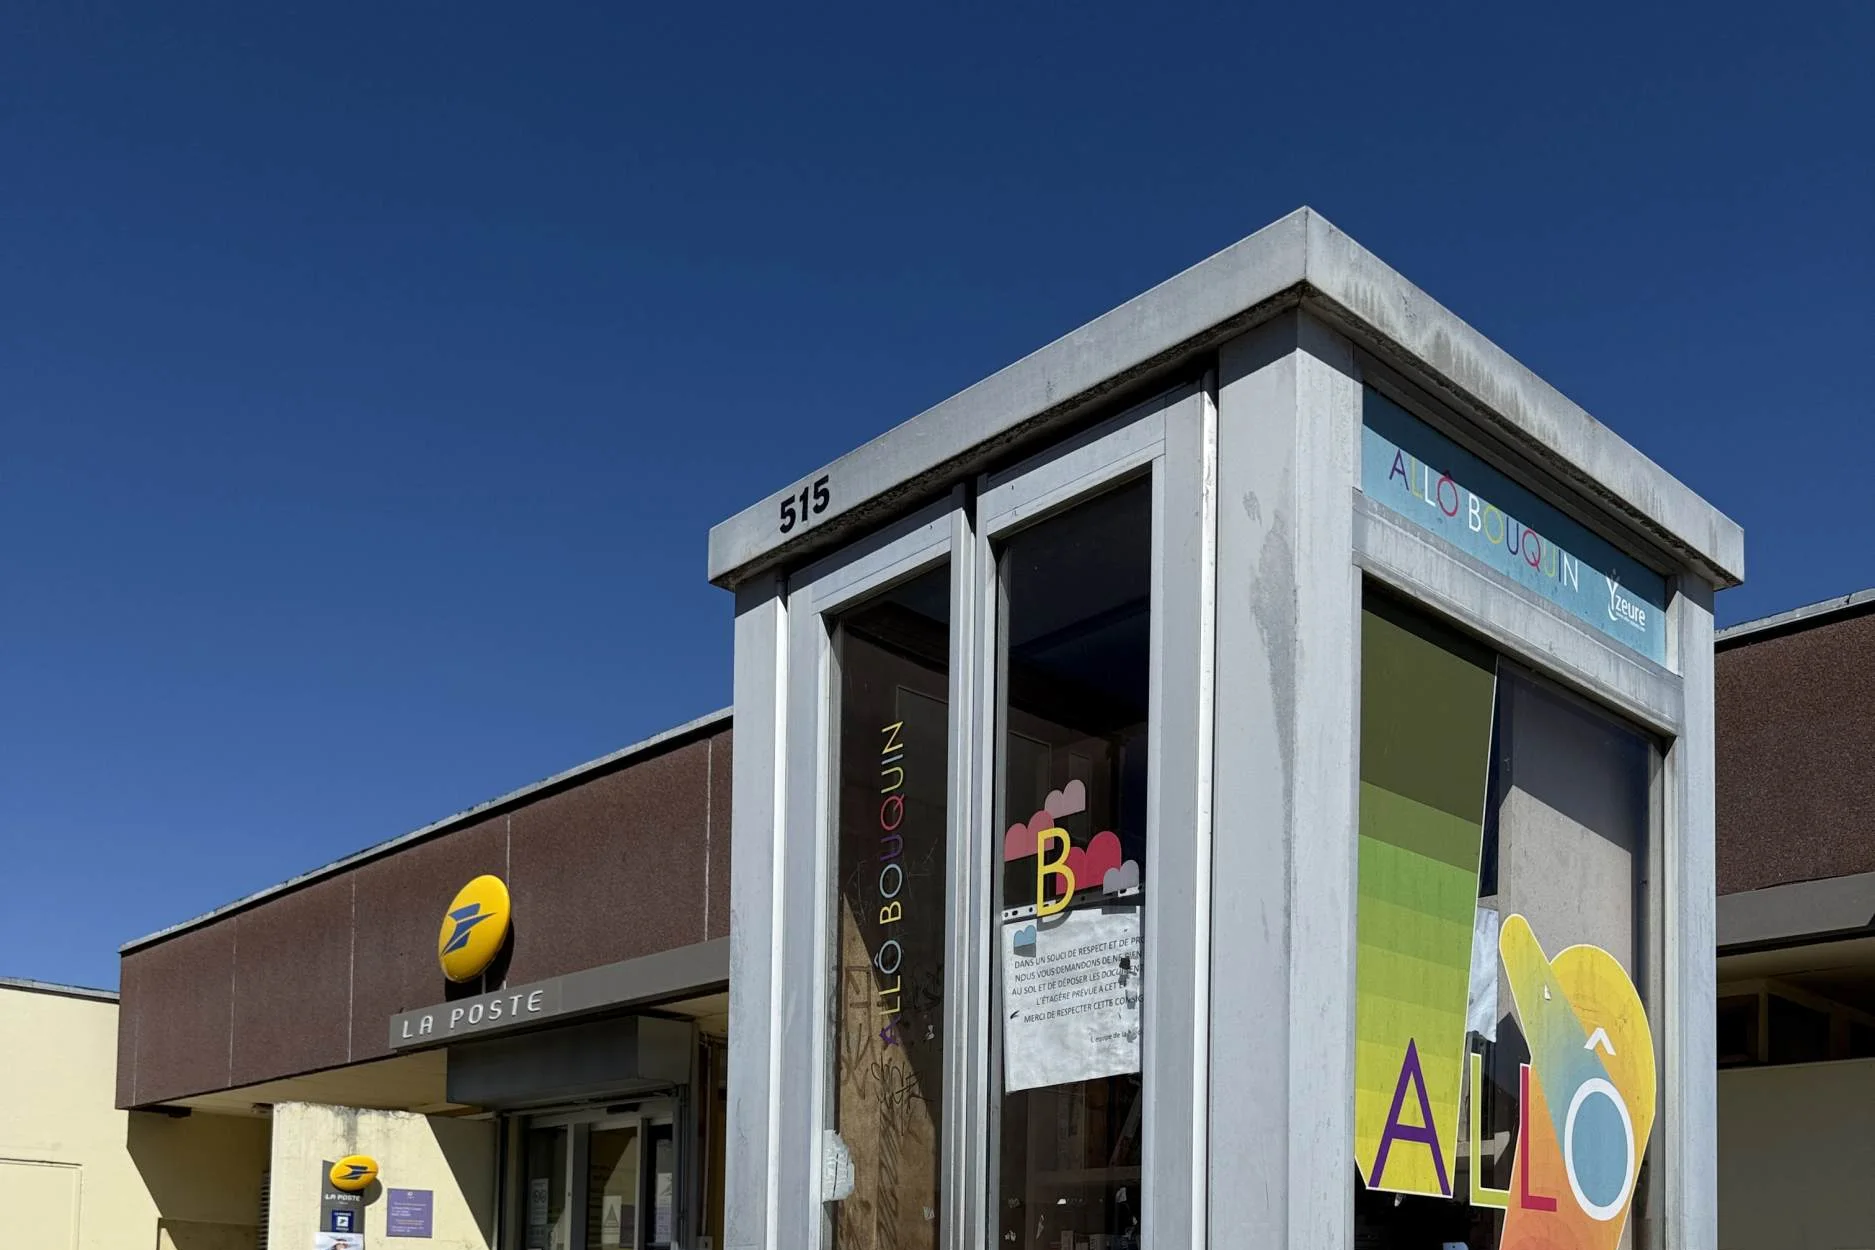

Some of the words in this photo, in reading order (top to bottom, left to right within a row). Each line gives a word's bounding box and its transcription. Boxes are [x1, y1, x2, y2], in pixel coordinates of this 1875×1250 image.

[779, 474, 830, 534] 515
[1467, 493, 1580, 593] BOUQUIN
[1605, 575, 1646, 626] Yzeure
[879, 720, 905, 925] BOUQUIN
[1036, 827, 1076, 918] B
[1014, 957, 1034, 969] DANS
[1035, 955, 1046, 965] UN
[1046, 951, 1067, 963] SOUCI
[1068, 948, 1077, 957] DE
[1078, 942, 1107, 957] RESPECT
[1108, 940, 1118, 950] ET
[1119, 937, 1129, 947] DE
[1015, 971, 1036, 982] NOUS
[1036, 967, 1057, 978] VOUS
[1057, 957, 1101, 975] DEMANDONS
[1101, 955, 1111, 965] DE
[1012, 987, 1022, 996] AU
[1024, 985, 1037, 994] SOL
[1038, 982, 1046, 992] ET
[1047, 980, 1057, 990] DE
[1089, 971, 1101, 981] LES
[402, 1015, 434, 1039] LA
[450, 990, 544, 1029] POSTE
[1023, 1012, 1046, 1023] MERCI
[1046, 1009, 1056, 1019] DE
[1056, 1003, 1092, 1016] RESPECTER
[1093, 998, 1114, 1009] CETTE
[1367, 1026, 1635, 1221] ALLÔ
